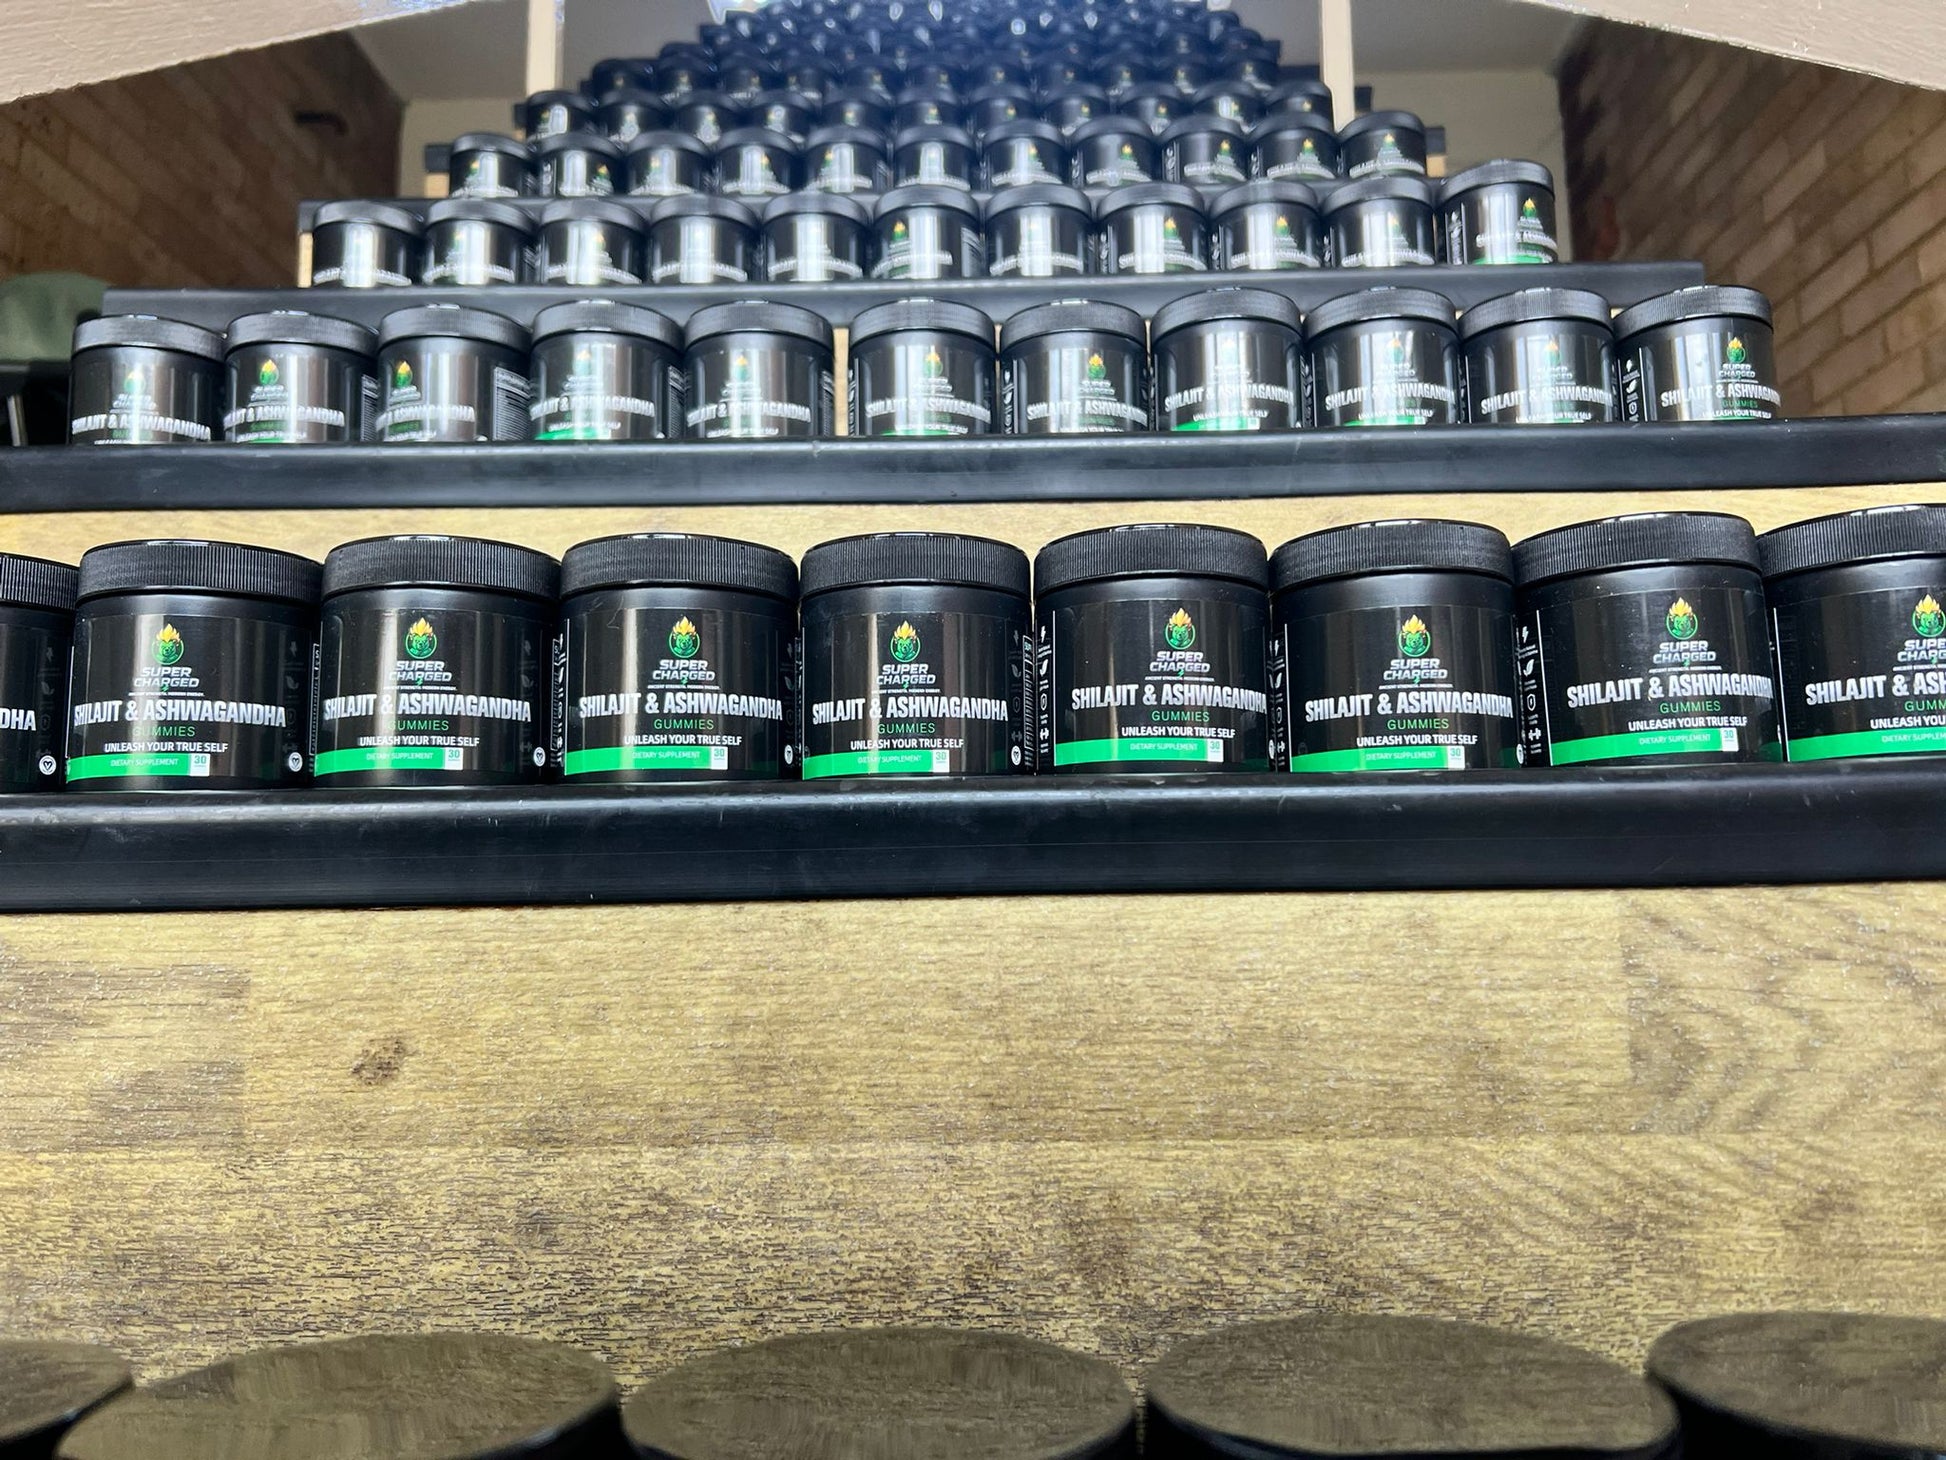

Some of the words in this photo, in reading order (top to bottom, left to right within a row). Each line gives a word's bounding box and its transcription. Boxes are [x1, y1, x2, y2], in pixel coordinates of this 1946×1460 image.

[1659, 640, 1708, 653] SUPER
[1156, 651, 1203, 662] SUPER
[1653, 651, 1716, 664] CHARGED
[396, 660, 445, 671] SUPER
[659, 659, 708, 670] SUPER
[1149, 661, 1210, 672] CHARGED
[1390, 658, 1440, 669] SUPER
[140, 666, 192, 677] SUPER
[881, 664, 929, 675] SUPER
[1383, 669, 1448, 680] CHARGED
[389, 671, 452, 682] CHARGED
[652, 670, 716, 681] CHARGED
[876, 674, 936, 684] CHARGED
[134, 677, 199, 687] CHARGED
[1566, 678, 1643, 708] SHILAJIT
[1648, 676, 1664, 699] &
[1805, 675, 1887, 706] SHILAJIT
[1892, 674, 1909, 697] &
[1072, 684, 1139, 711] SHILAJIT
[1142, 685, 1157, 706] &
[1161, 684, 1267, 714] ASHWAGANDHA
[323, 694, 377, 721] SHILAJIT
[381, 694, 394, 714] &
[399, 693, 532, 722] ASHWAGANDHA
[579, 693, 641, 718] SHILAJIT
[645, 693, 660, 714] &
[663, 692, 783, 721] ASHWAGANDHA
[812, 698, 865, 725] SHILAJIT
[869, 697, 883, 718] &
[886, 696, 1009, 722] ASHWAGANDHA
[1305, 694, 1373, 722] SHILAJIT
[1377, 693, 1392, 714] &
[1396, 691, 1513, 718] ASHWAGANDHA
[1660, 700, 1720, 714] GUMMIES
[74, 700, 122, 726] SHILAJIT
[125, 700, 139, 721] &
[143, 700, 287, 728] ASHWAGANDHA
[1151, 710, 1210, 722] GUMMIES
[387, 720, 449, 731] GUMMIES
[654, 719, 715, 730] GUMMIES
[1387, 718, 1449, 730] GUMMIES
[1628, 718, 1676, 731] UNLEASH
[1677, 717, 1706, 728] YOUR
[1706, 716, 1729, 726] TRUE
[1729, 716, 1748, 726] SELF
[1870, 716, 1922, 729] UNLEASH
[132, 726, 196, 737] GUMMIES
[878, 723, 936, 734] GUMMIES
[1122, 727, 1165, 737] UNLEASH
[1166, 727, 1193, 736] YOUR
[1194, 727, 1217, 737] TRUE
[1217, 728, 1235, 738] SELF
[1724, 730, 1734, 739] 30
[360, 736, 400, 746] UNLEASH
[402, 736, 429, 746] YOUR
[430, 736, 456, 746] TRUE
[457, 737, 480, 747] SELF
[624, 735, 668, 745] UNLEASH
[669, 735, 696, 744] YOUR
[697, 735, 721, 745] TRUE
[722, 736, 742, 746] SELF
[850, 739, 890, 750] UNLEASH
[891, 739, 918, 748] YOUR
[918, 738, 943, 748] TRUE
[943, 739, 964, 749] SELF
[1210, 741, 1220, 750] 30
[1356, 736, 1402, 747] UNLEASH
[1403, 735, 1432, 745] YOUR
[1433, 735, 1457, 744] TRUE
[1458, 735, 1478, 745] SELF
[105, 742, 146, 753] UNLEASH
[147, 742, 174, 752] YOUR
[176, 742, 203, 752] TRUE
[204, 743, 228, 753] SELF
[713, 748, 725, 757] 30
[1450, 748, 1461, 757] 30
[194, 754, 207, 764] 30
[448, 750, 460, 759] 30
[935, 752, 947, 760] 30
